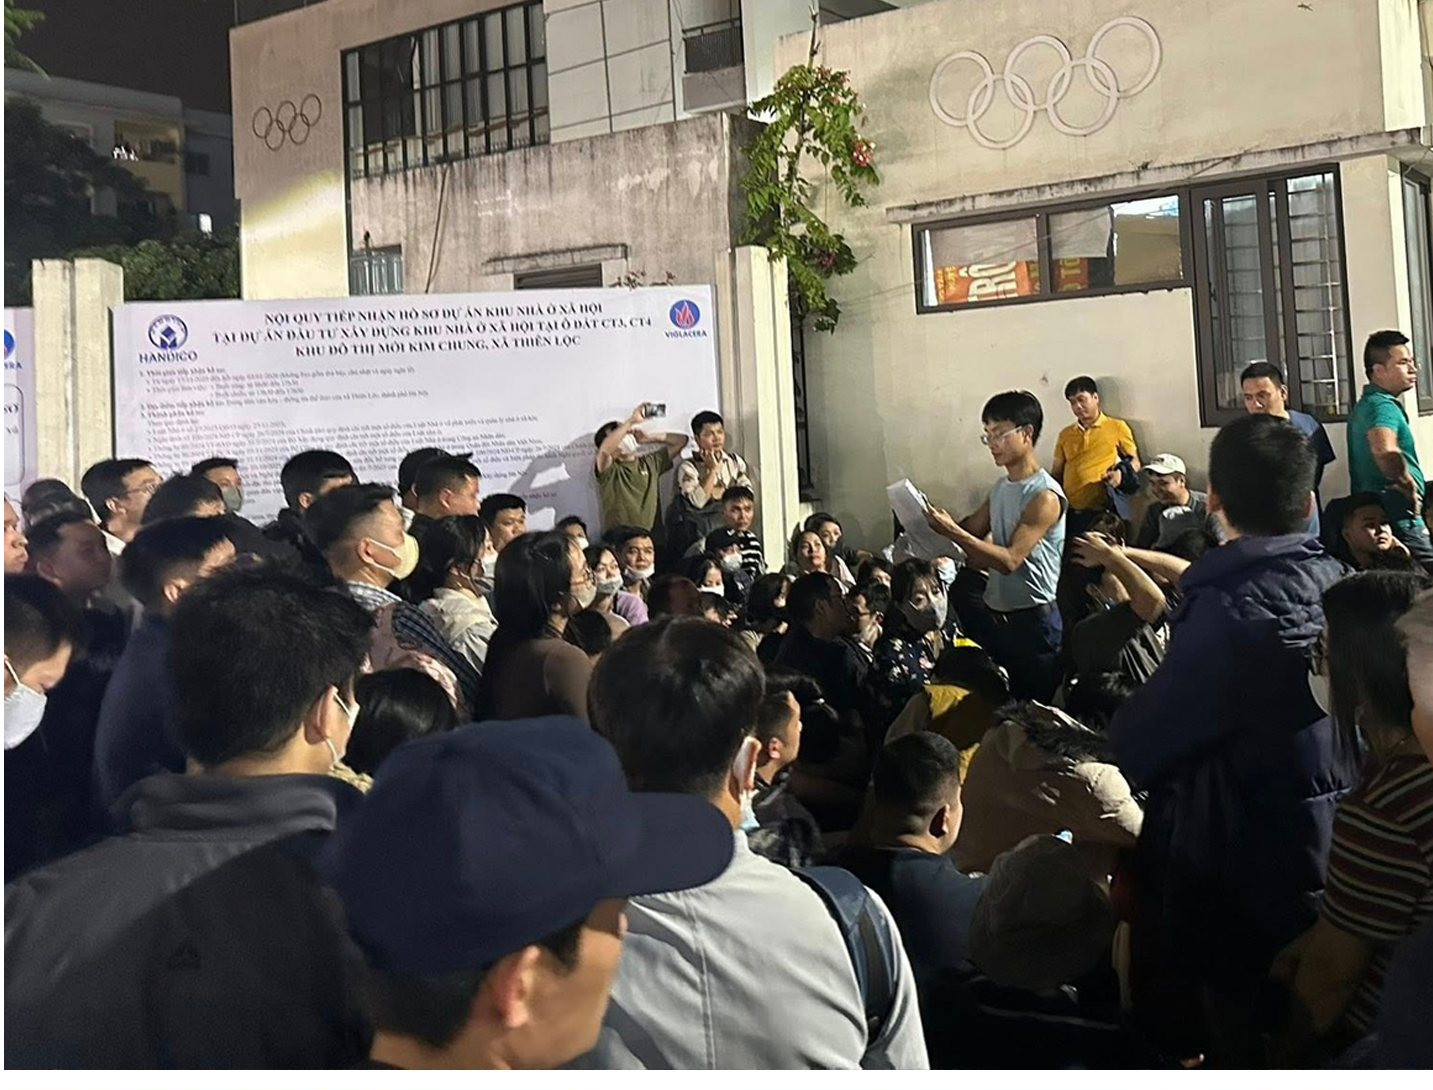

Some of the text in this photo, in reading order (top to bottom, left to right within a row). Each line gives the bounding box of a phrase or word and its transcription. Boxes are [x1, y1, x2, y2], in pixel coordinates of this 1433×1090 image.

[293, 311, 322, 325] QUY
[486, 306, 513, 317] KHU
[414, 325, 441, 336] KHU
[629, 317, 651, 327] CT4
[138, 352, 198, 363] HANDICO
[295, 346, 325, 357] KHU
[409, 341, 435, 353] KIM
[439, 340, 488, 351] CHUNG,
